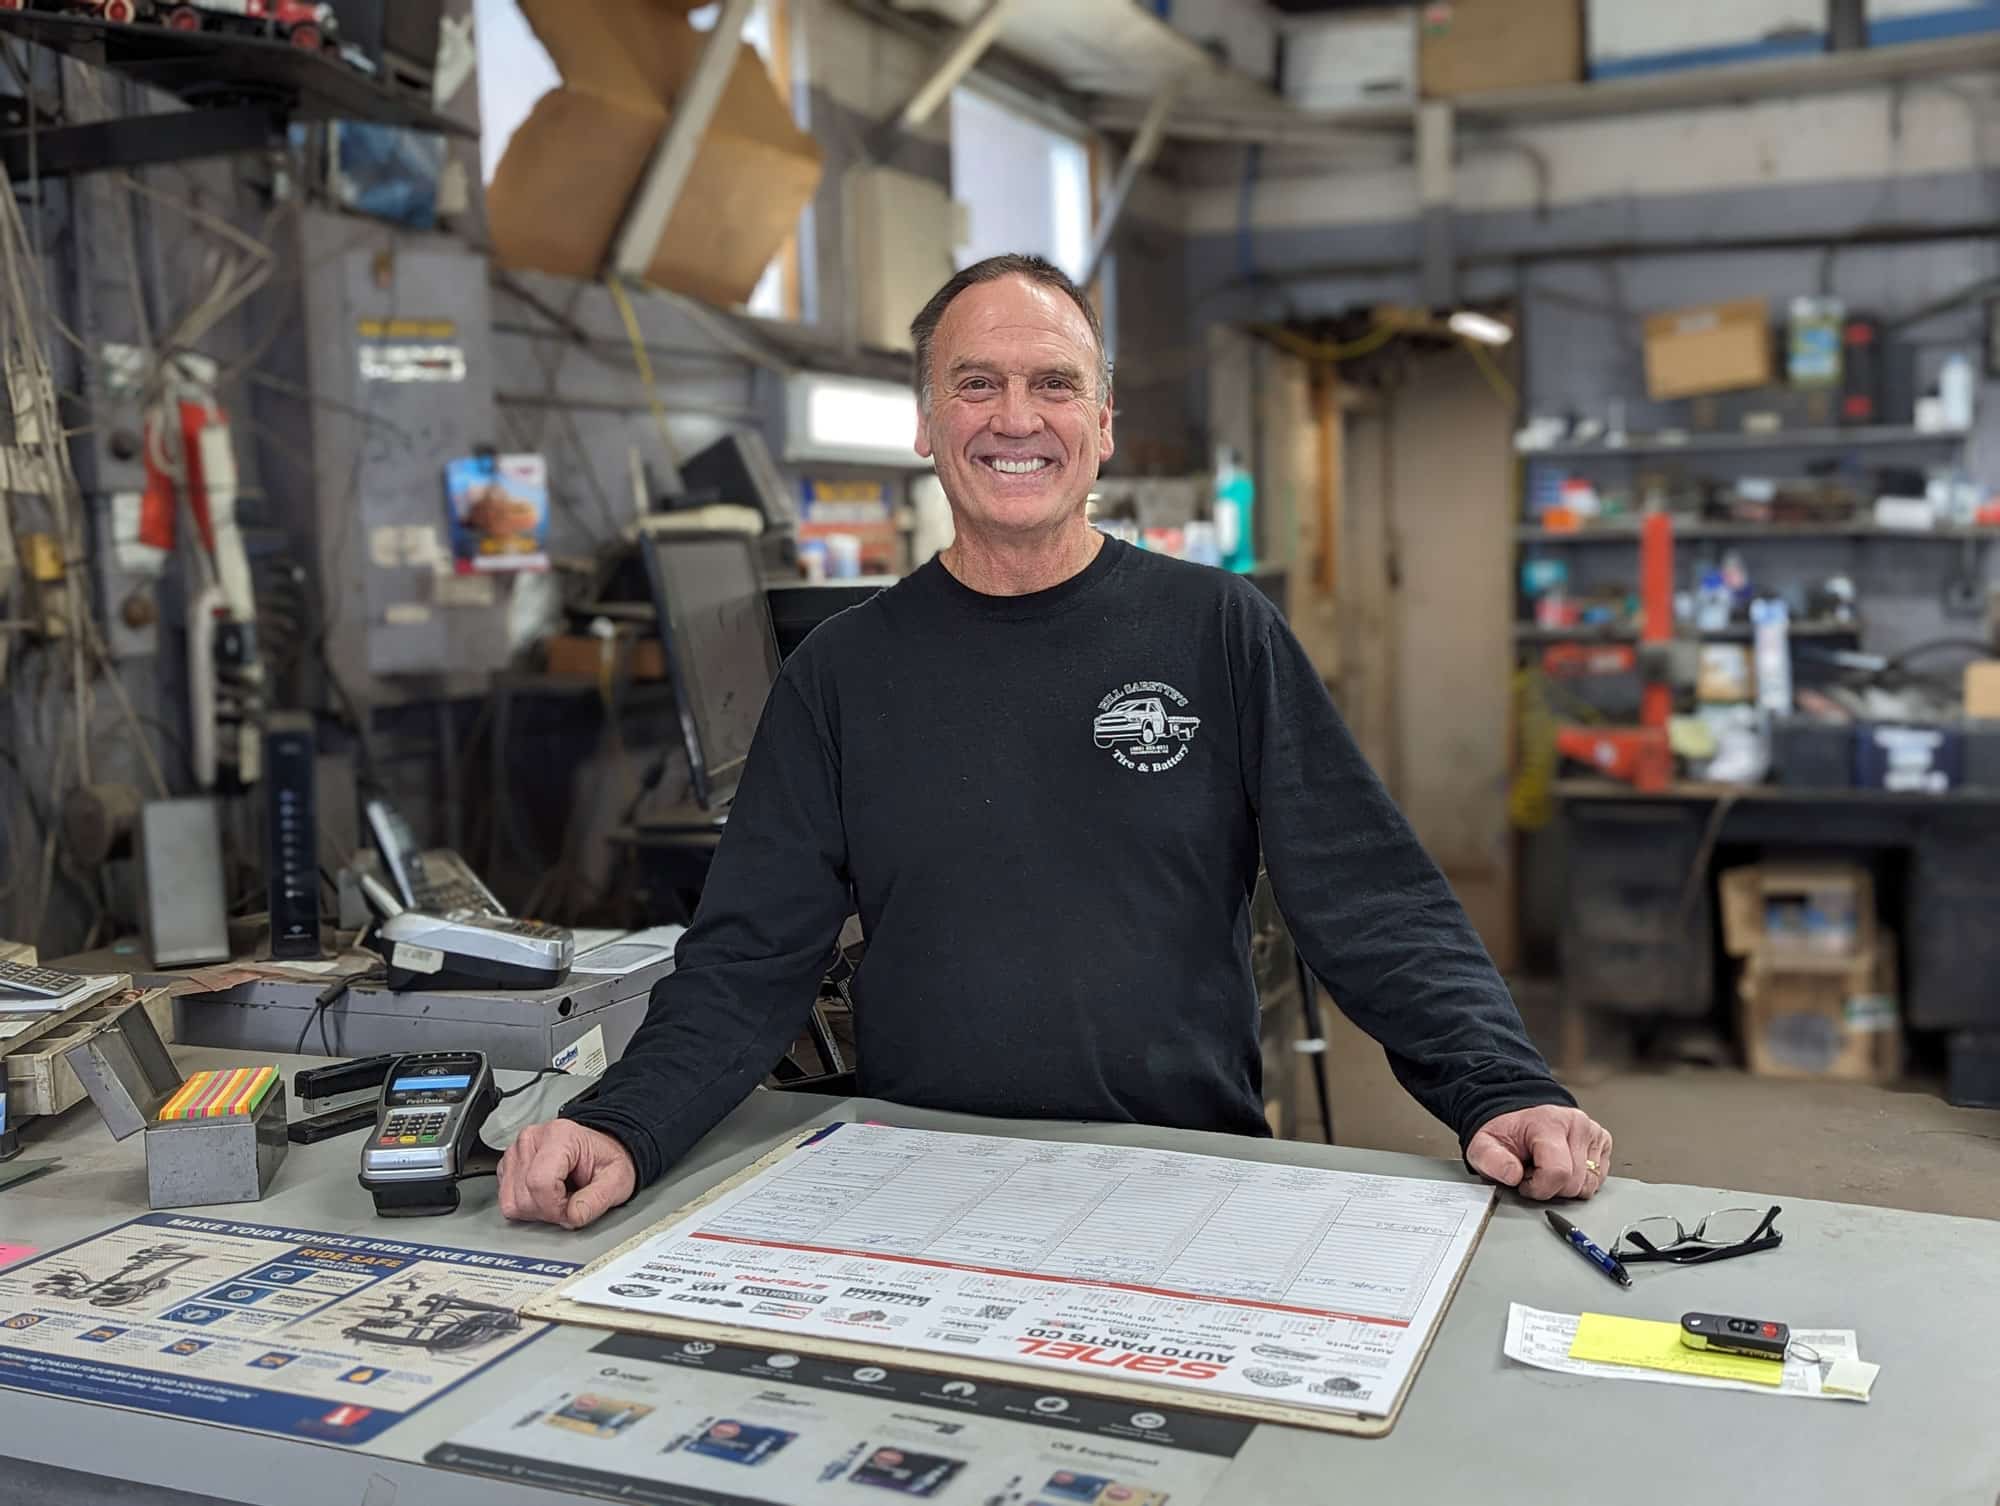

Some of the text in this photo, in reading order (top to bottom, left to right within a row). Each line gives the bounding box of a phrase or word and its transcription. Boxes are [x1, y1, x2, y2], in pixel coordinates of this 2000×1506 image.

[1112, 748, 1135, 769] Tire
[1137, 763, 1149, 772] &
[1152, 744, 1189, 772] Battery
[167, 1218, 577, 1276] MAKE YOUR VEHICLE RIDE LIKE NEW... AGA
[298, 1248, 405, 1269] RIDE SAFE
[658, 1254, 702, 1264] Services
[705, 1260, 733, 1268] Shop
[643, 1263, 705, 1277] WAGNER
[735, 1264, 778, 1274] Machine
[627, 1271, 683, 1284] EXIDE
[815, 1273, 873, 1286] Equipment
[687, 1282, 726, 1292] WIX
[889, 1281, 918, 1291] Tools
[957, 1291, 1027, 1305] Accessories
[1067, 1304, 1098, 1314] Parts
[1101, 1309, 1134, 1320] Truck
[1056, 1311, 1222, 1339] www.sanelautoparts.net
[1137, 1314, 1156, 1323] HD
[1025, 1326, 1065, 1340] CO.
[1199, 1323, 1252, 1336] Supplies
[1068, 1332, 1155, 1354] PARTS
[1326, 1340, 1360, 1351] Parts
[1161, 1347, 1235, 1364] AUTO
[1367, 1346, 1395, 1355] Auto
[1077, 1447, 1159, 1466] Equipment
